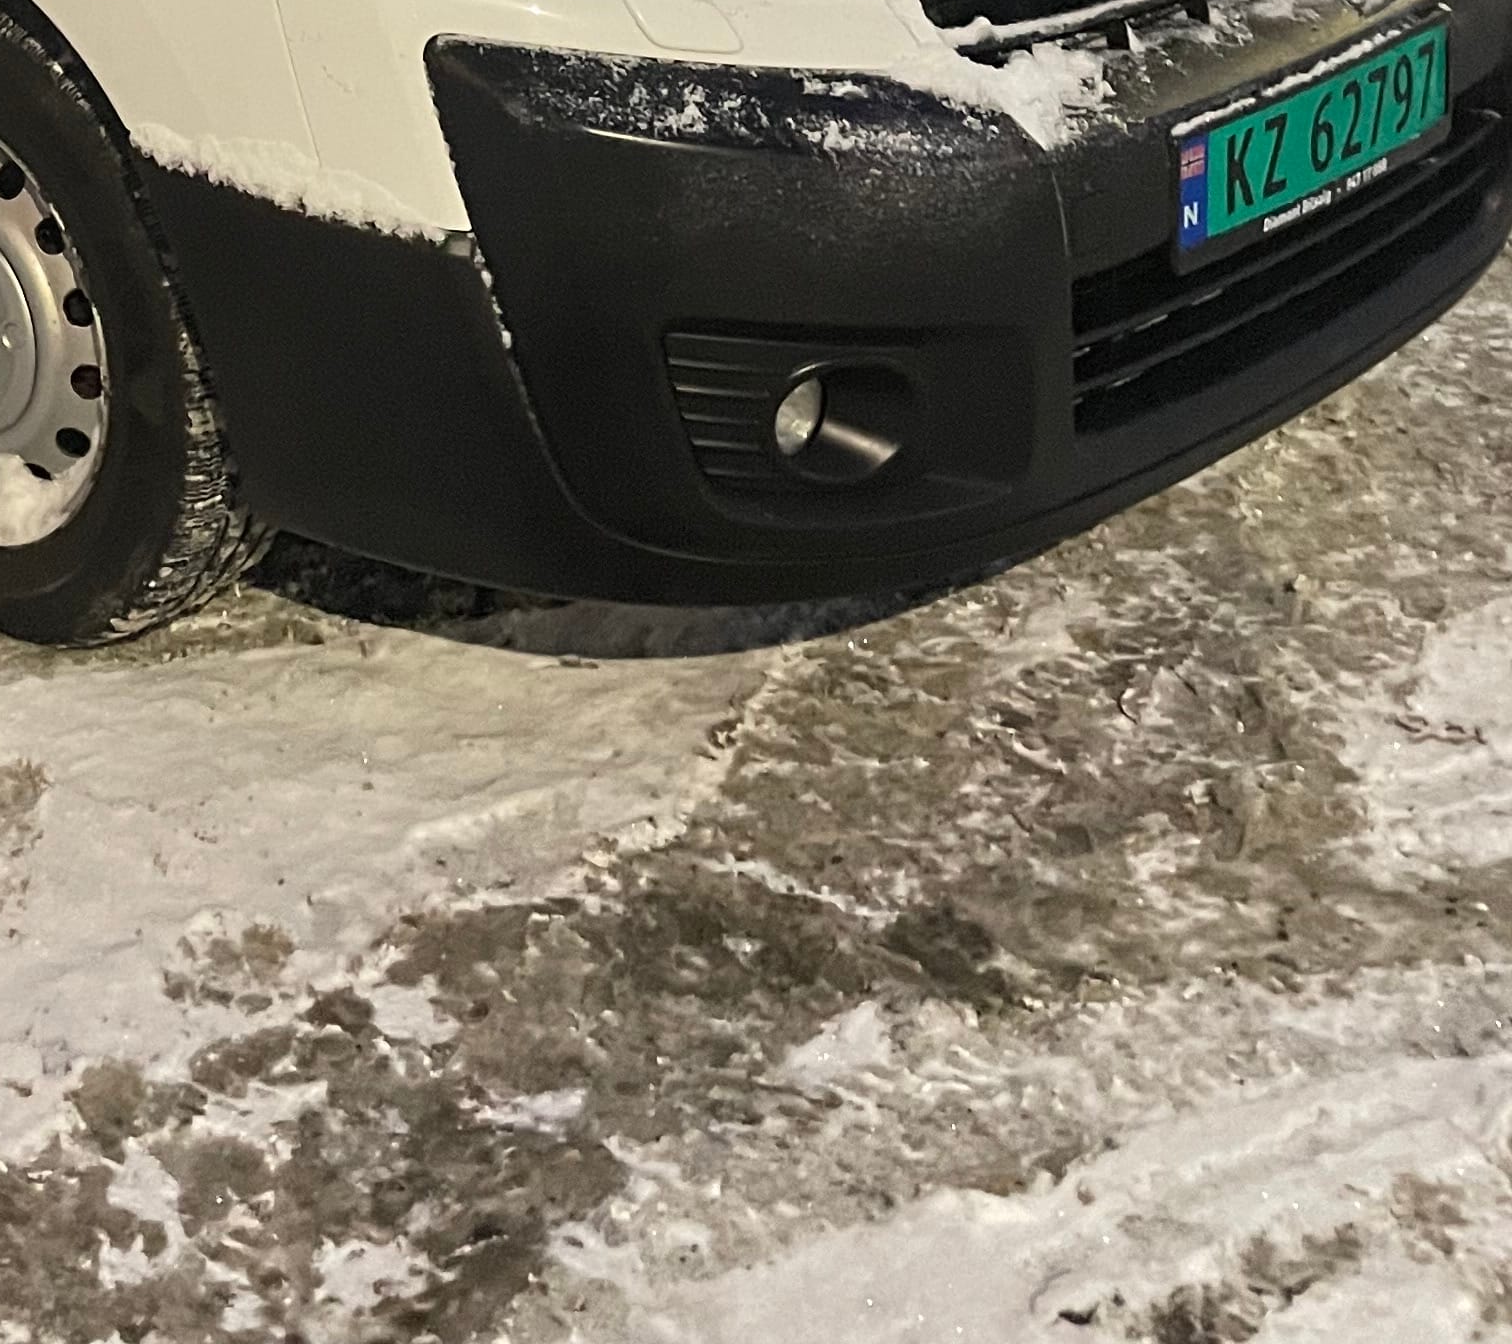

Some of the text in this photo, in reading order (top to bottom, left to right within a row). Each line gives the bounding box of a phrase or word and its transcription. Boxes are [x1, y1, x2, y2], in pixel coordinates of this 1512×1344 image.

[1226, 40, 1436, 216] KZ 62797
[1183, 201, 1199, 229] N
